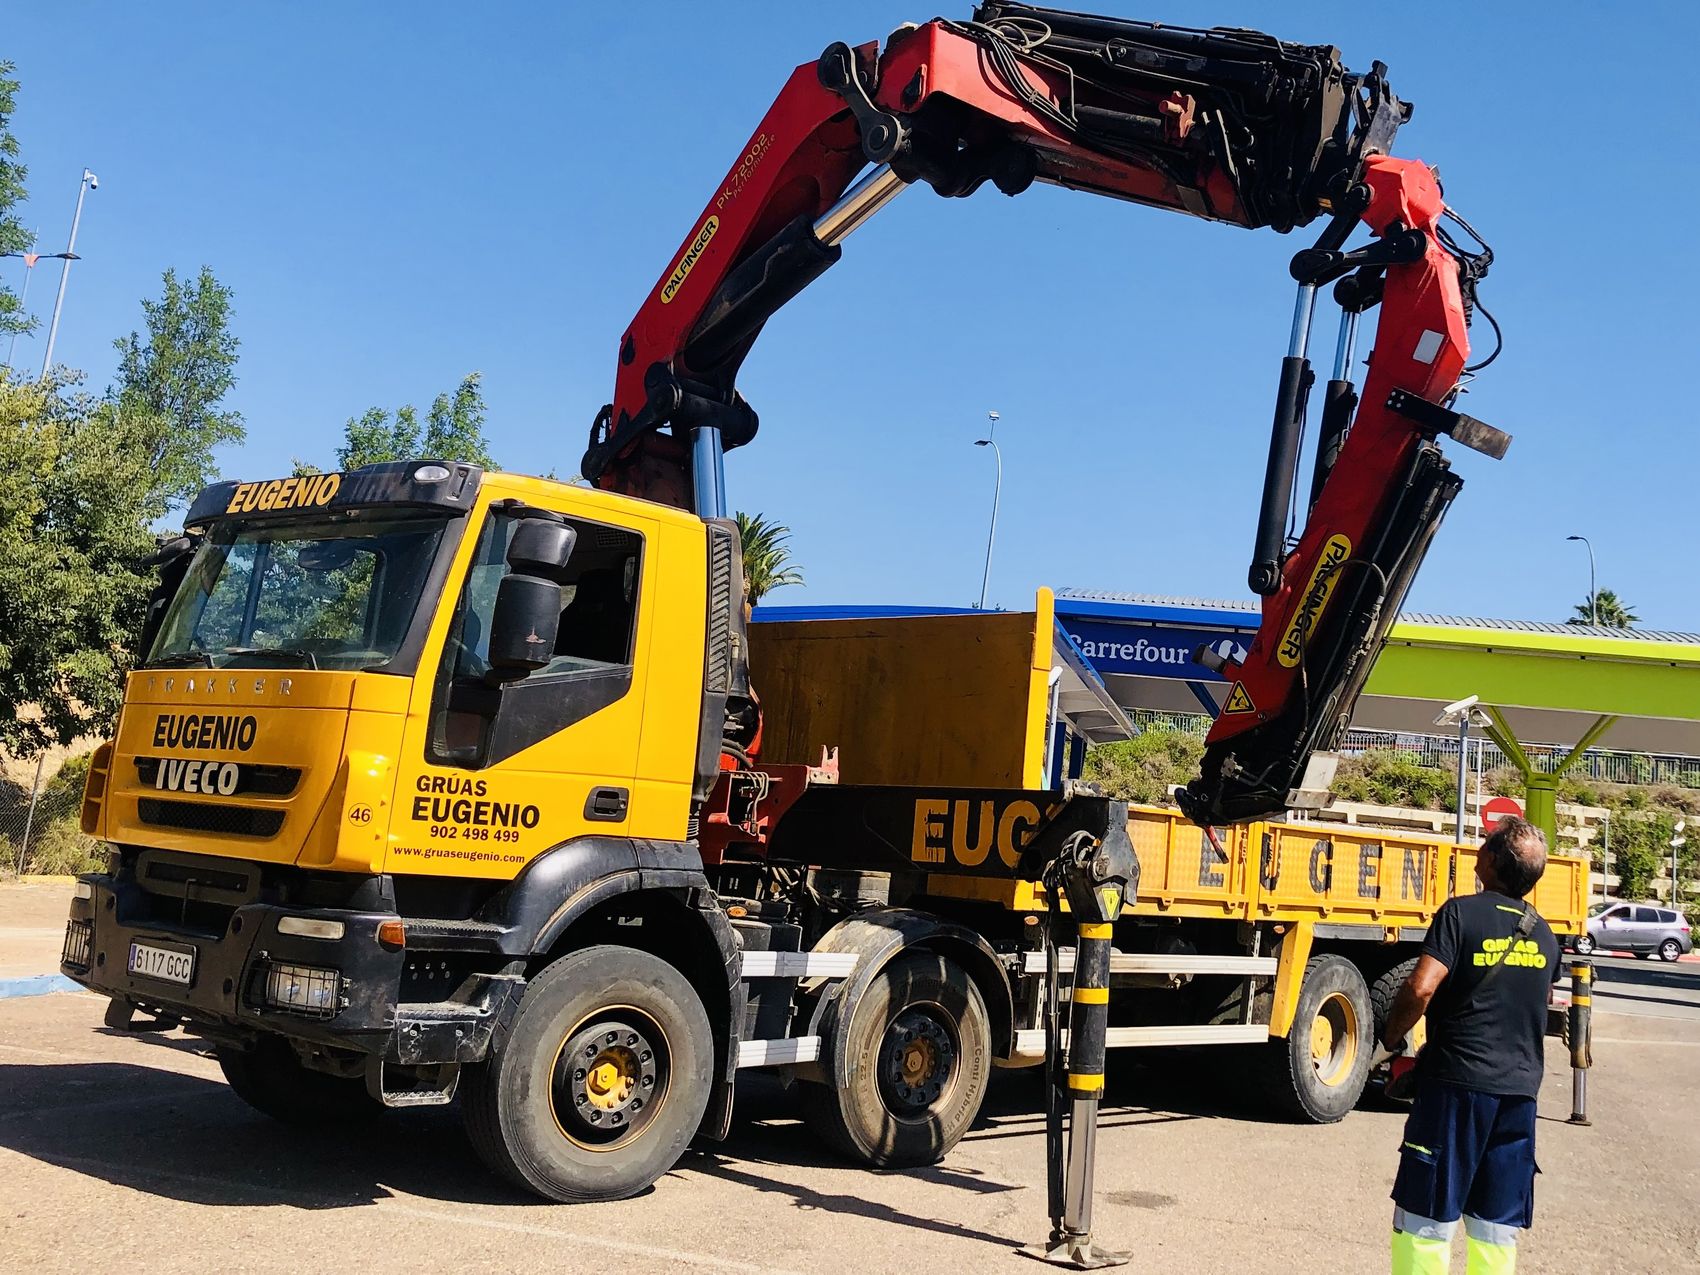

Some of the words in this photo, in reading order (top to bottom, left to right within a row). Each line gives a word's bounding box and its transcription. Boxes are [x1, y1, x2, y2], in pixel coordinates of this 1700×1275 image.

[716, 187, 733, 210] PK
[731, 133, 768, 187] 72002
[663, 220, 717, 299] PALFINGER
[225, 473, 341, 514] EUGENIO
[146, 677, 293, 696] TRAKKER
[153, 714, 258, 752] EUGENIO
[155, 758, 240, 797] IVECO
[416, 773, 488, 797] GRÚAS
[350, 807, 372, 823] 46
[411, 796, 540, 829] EUGENIO
[430, 825, 458, 839] 902
[462, 827, 489, 841] 498
[493, 829, 520, 843] 499
[911, 799, 1054, 869] EUG
[393, 846, 525, 864] www.gruaseugenio.com
[136, 948, 165, 974] 6117
[166, 955, 190, 979] GCC
[1473, 952, 1547, 969] EUENIO
